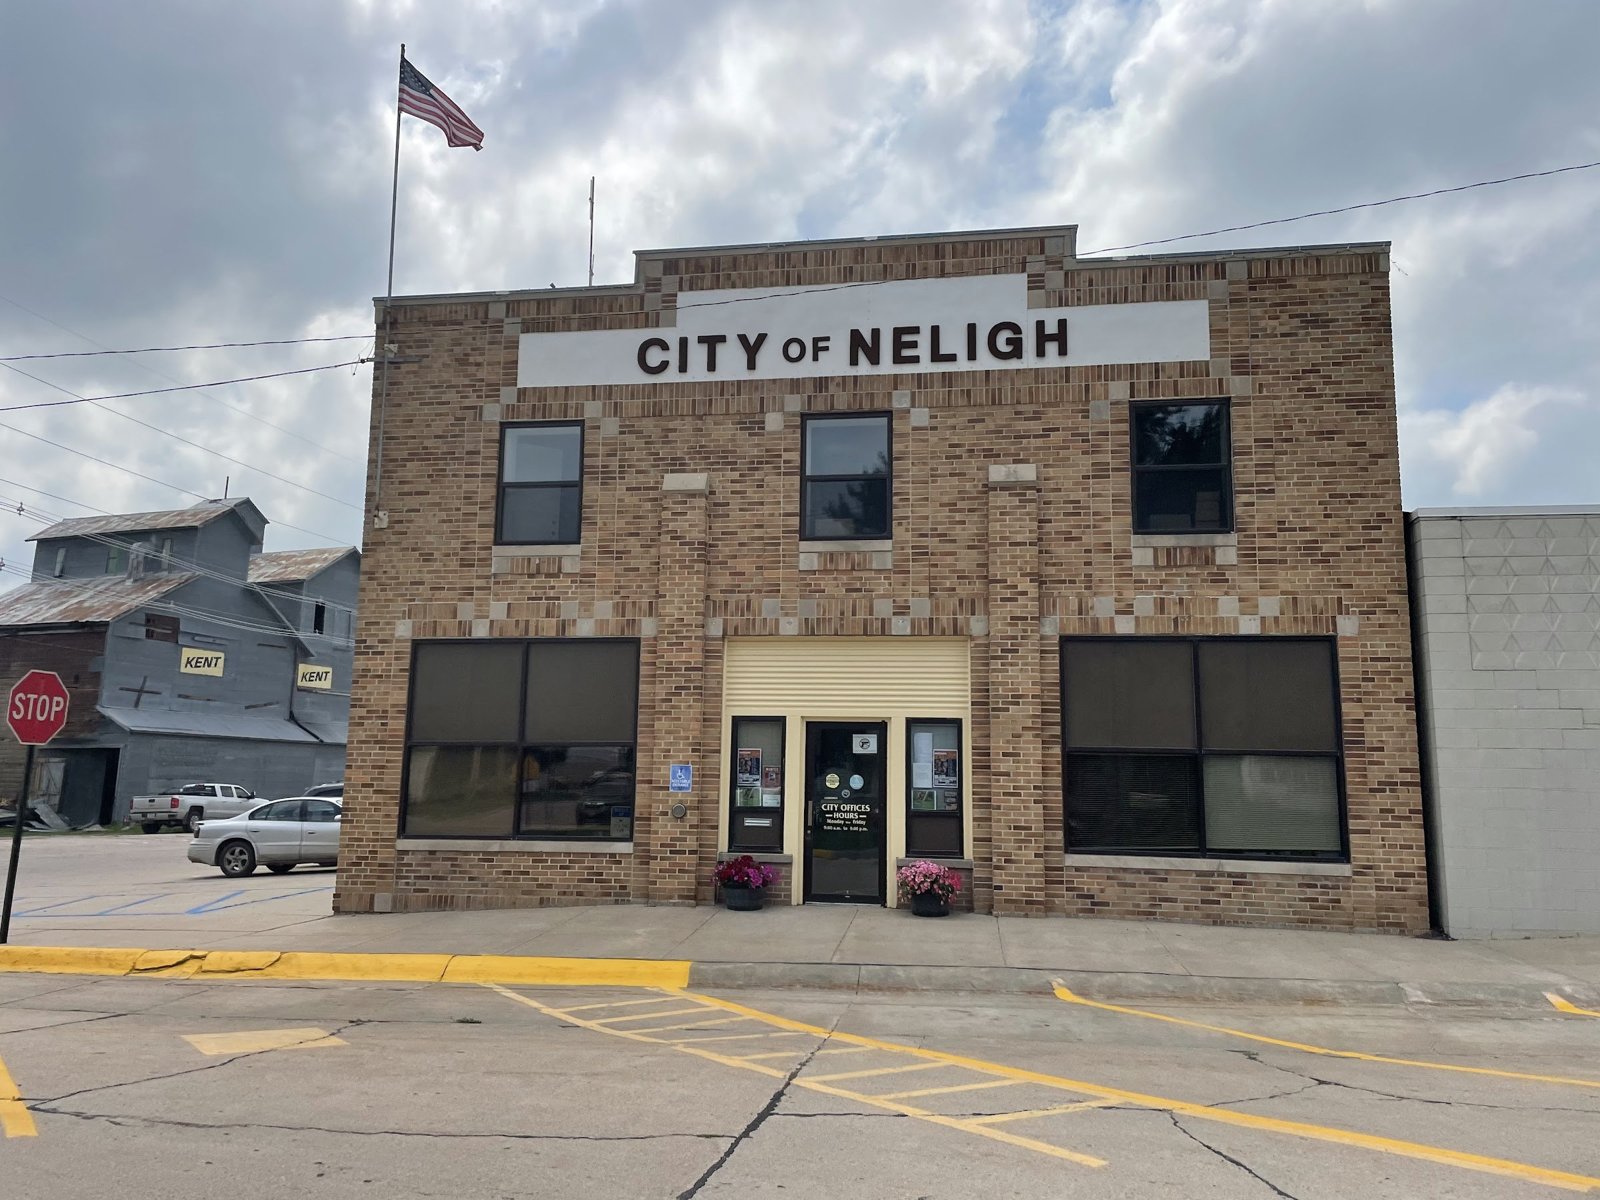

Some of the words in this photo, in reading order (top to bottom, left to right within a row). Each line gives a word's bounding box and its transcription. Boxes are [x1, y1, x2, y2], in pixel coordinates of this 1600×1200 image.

[637, 332, 768, 375] CITY
[782, 336, 830, 363] OF
[849, 318, 1068, 366] NELIGH
[185, 656, 222, 669] KENT
[301, 671, 330, 682] KENT
[12, 692, 64, 721] STOP
[821, 803, 838, 811] CITY
[840, 804, 870, 812] OFFICES
